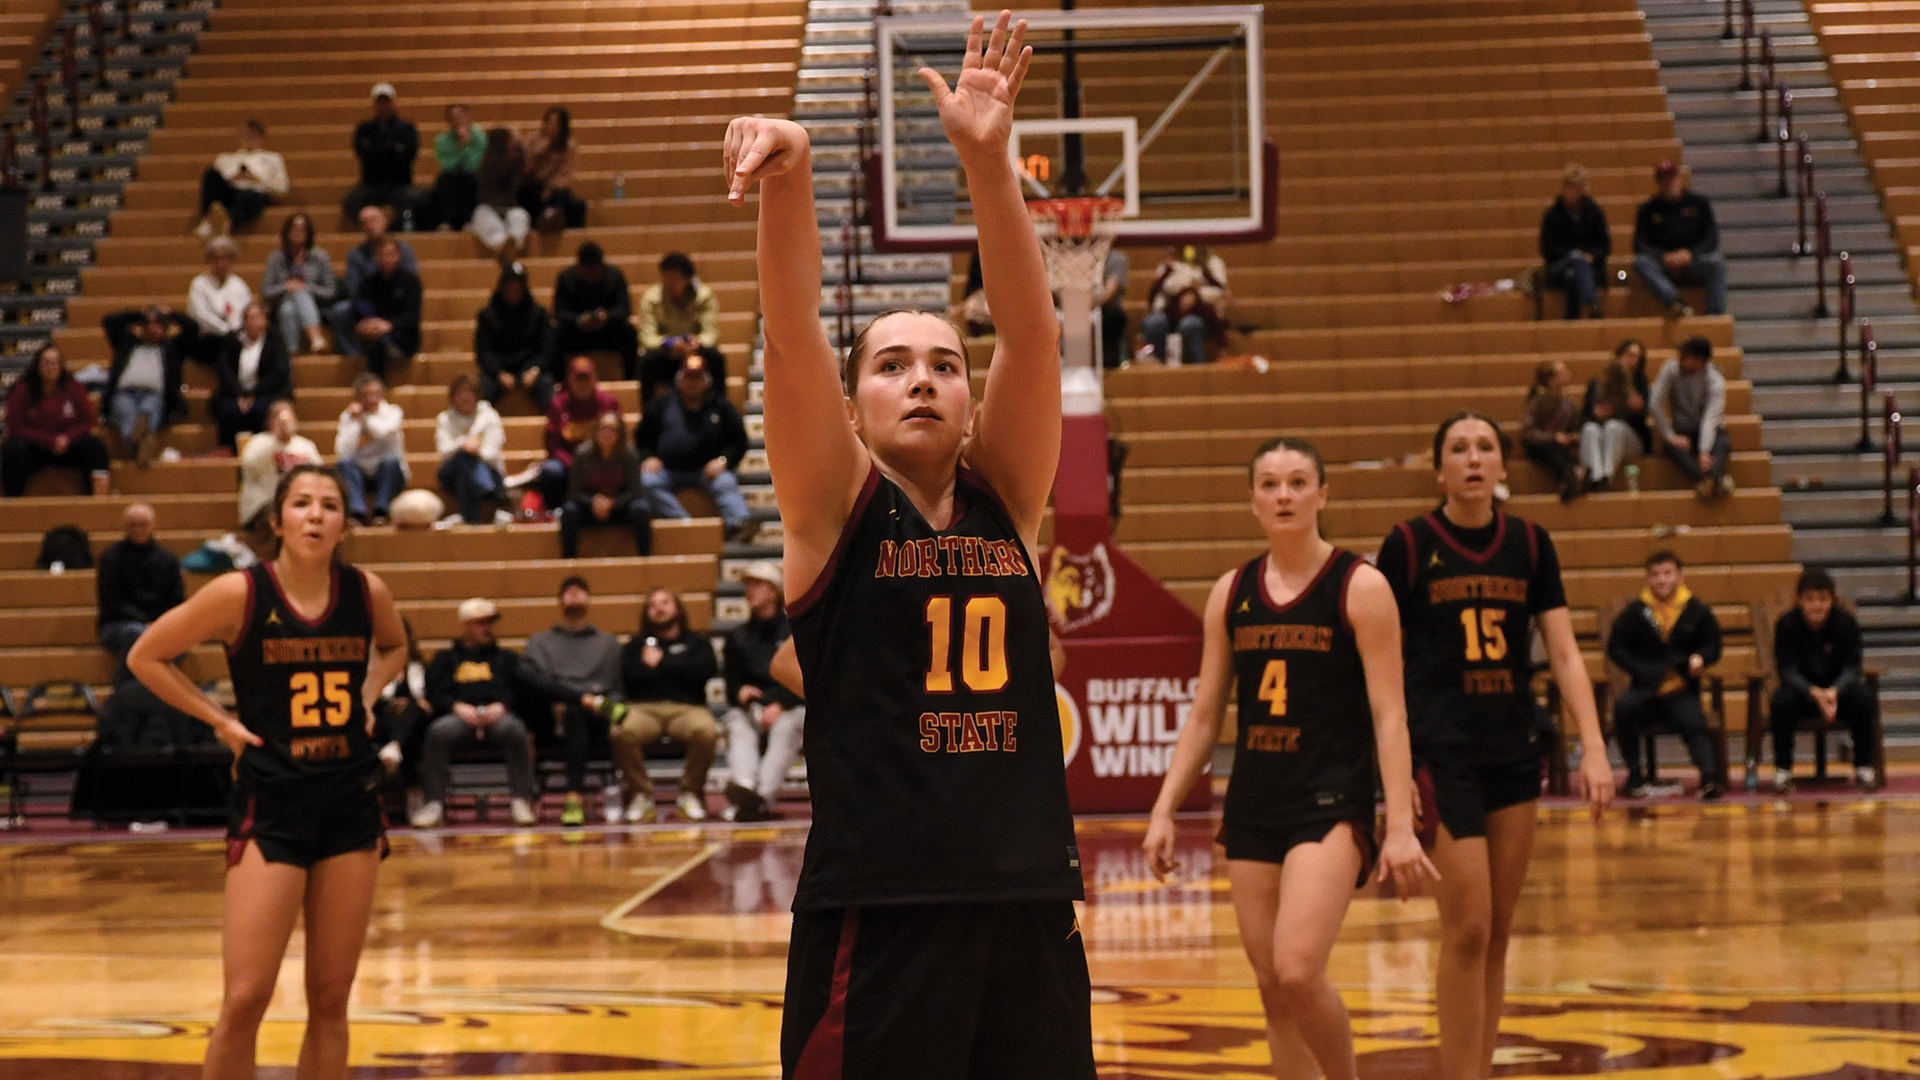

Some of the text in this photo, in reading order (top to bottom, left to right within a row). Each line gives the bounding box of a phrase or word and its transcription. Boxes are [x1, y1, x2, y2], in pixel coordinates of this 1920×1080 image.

[875, 536, 1028, 578] NORTHERN
[924, 594, 1011, 694] 10
[1460, 607, 1508, 661] 15
[290, 671, 351, 727] 25
[1257, 659, 1287, 716] 4
[919, 711, 1018, 753] STATE
